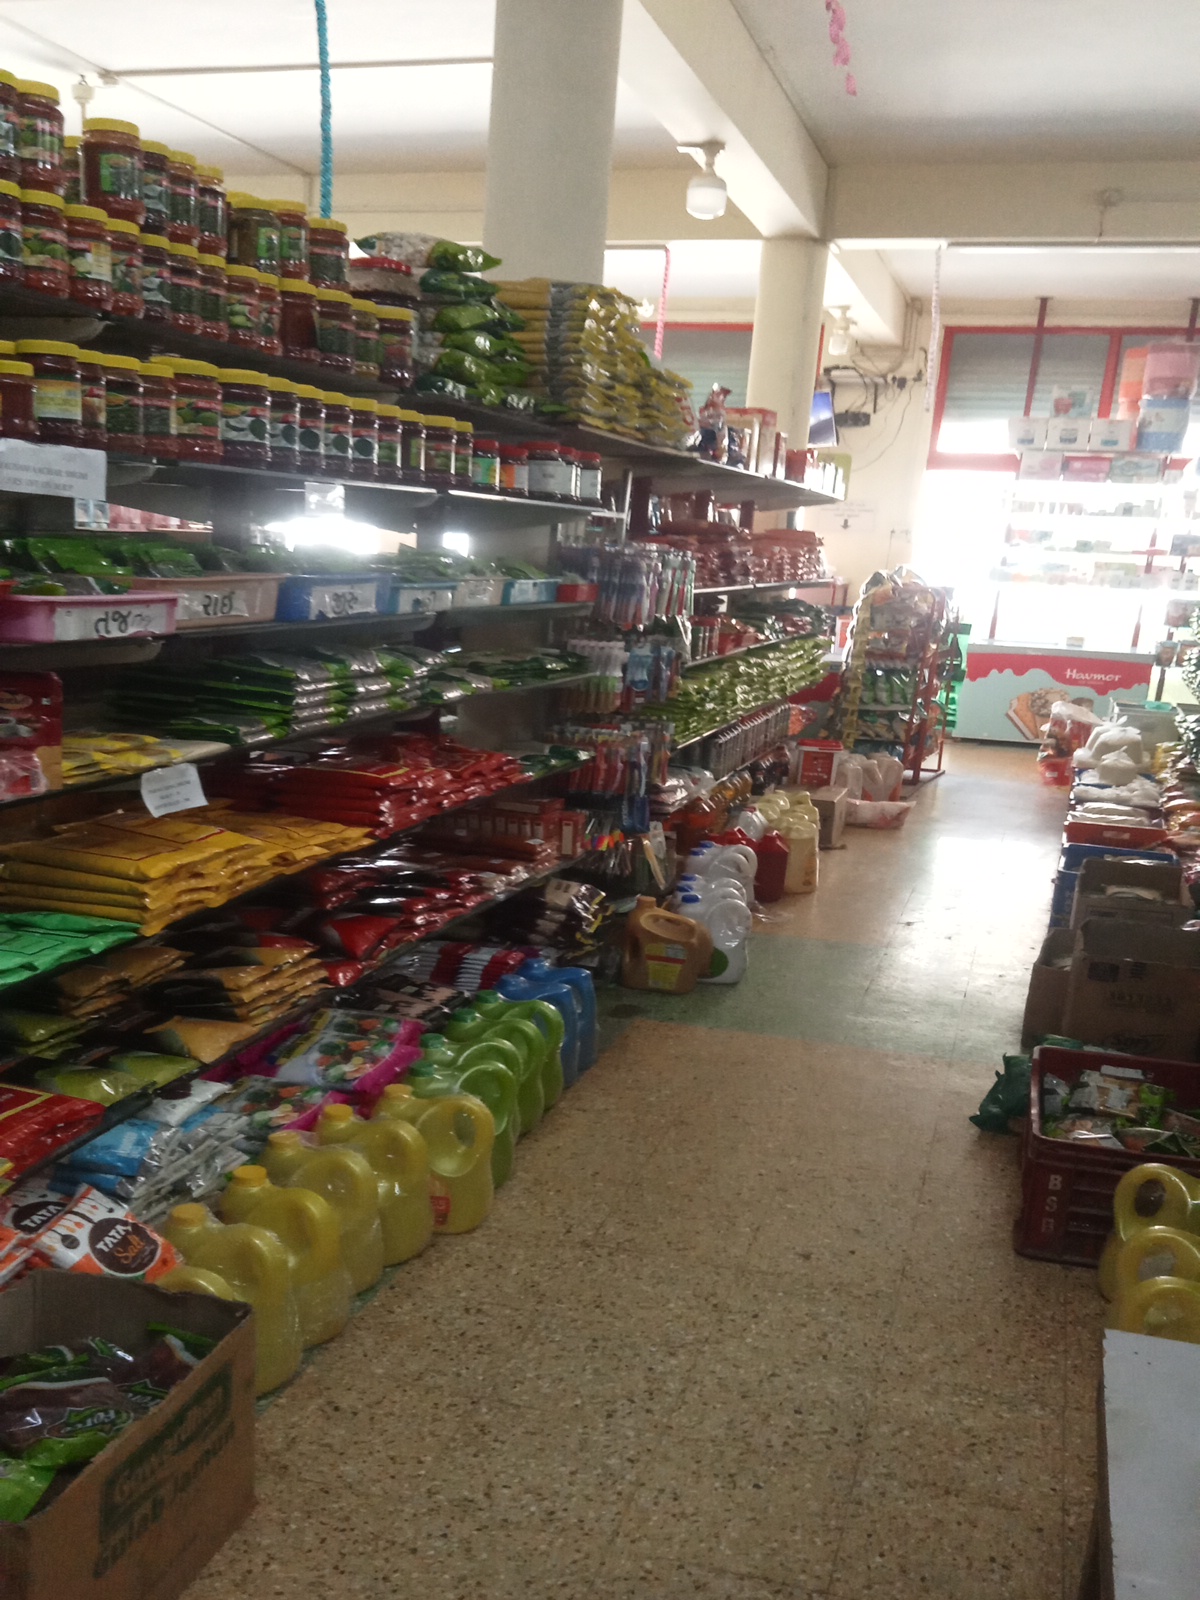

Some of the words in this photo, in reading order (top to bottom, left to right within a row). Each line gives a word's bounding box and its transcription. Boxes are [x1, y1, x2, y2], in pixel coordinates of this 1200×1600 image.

[1064, 668, 1122, 682] Havmor
[20, 1205, 63, 1228] TATA
[95, 1224, 132, 1253] TATA
[114, 1233, 146, 1264] Salt
